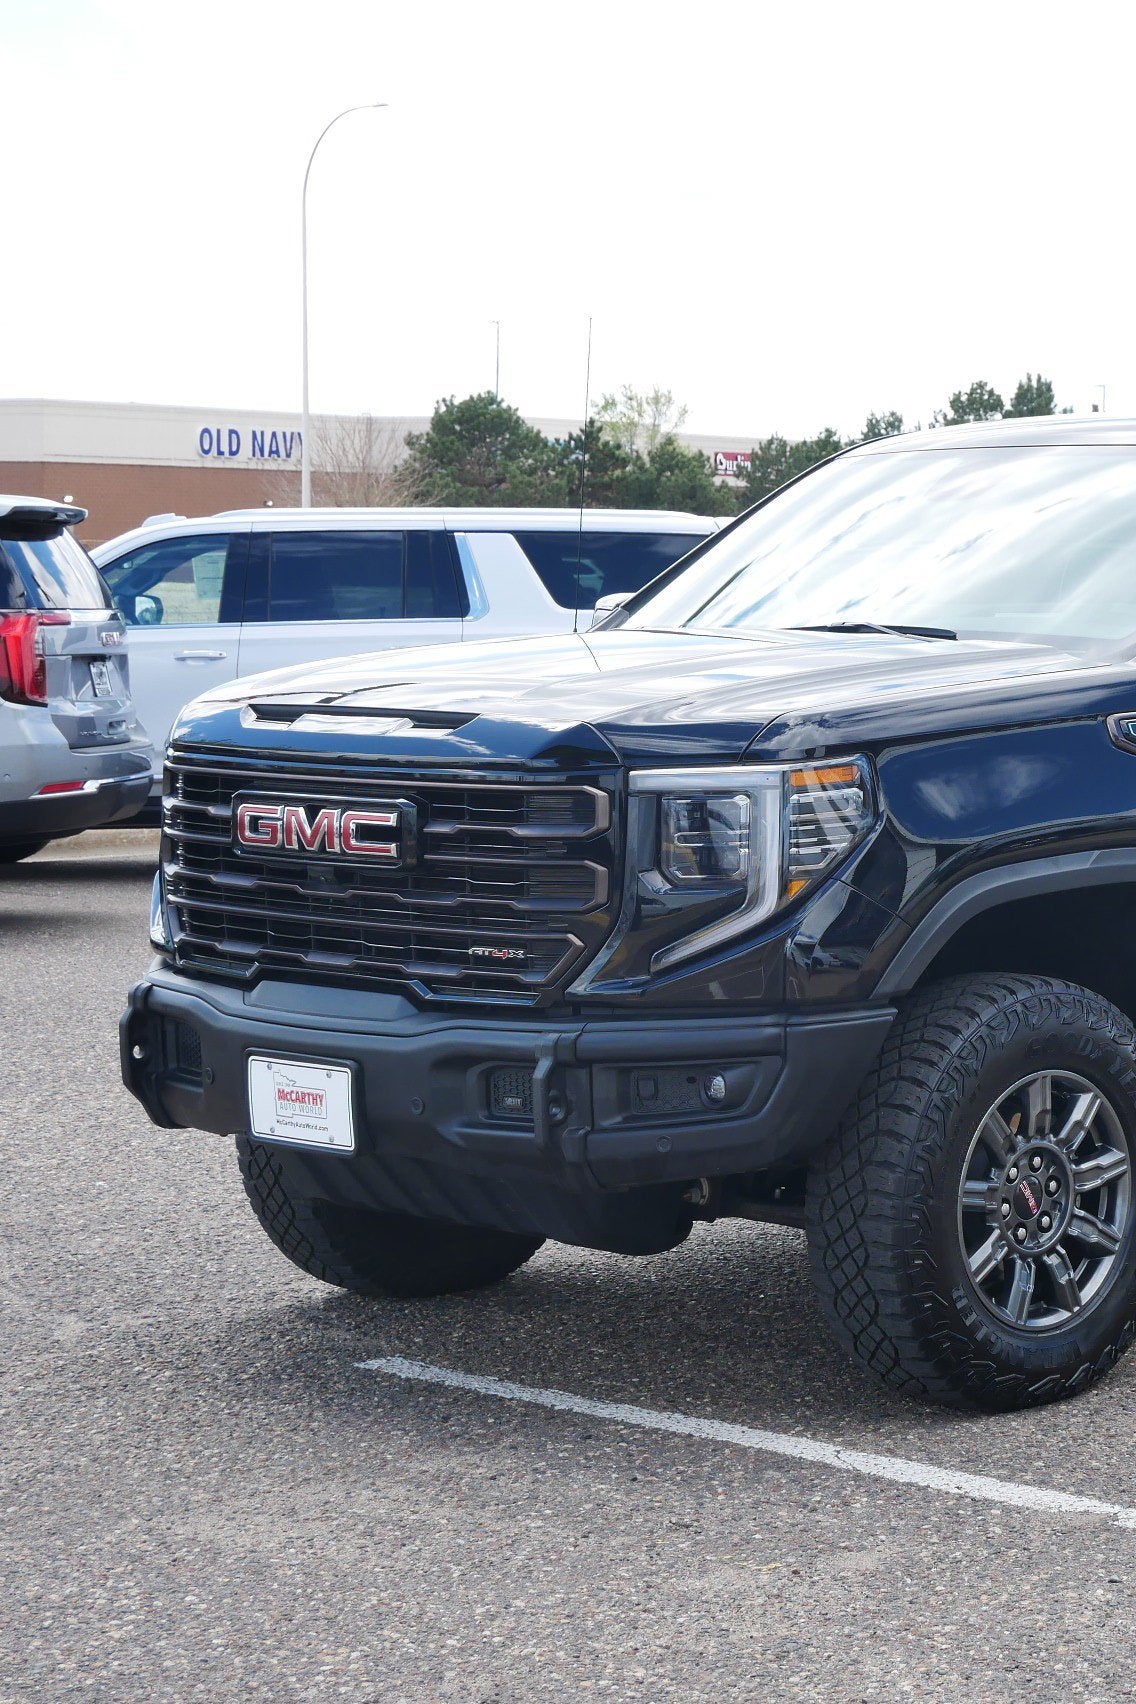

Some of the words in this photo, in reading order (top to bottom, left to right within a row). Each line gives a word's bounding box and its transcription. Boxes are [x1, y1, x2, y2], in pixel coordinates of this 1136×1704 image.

[199, 427, 241, 456] OLD
[237, 803, 399, 858] GMC
[468, 946, 526, 960] AT4X
[277, 1088, 324, 1107] McCARTHY
[279, 1102, 297, 1112] AUTO
[298, 1104, 323, 1116] WORLD
